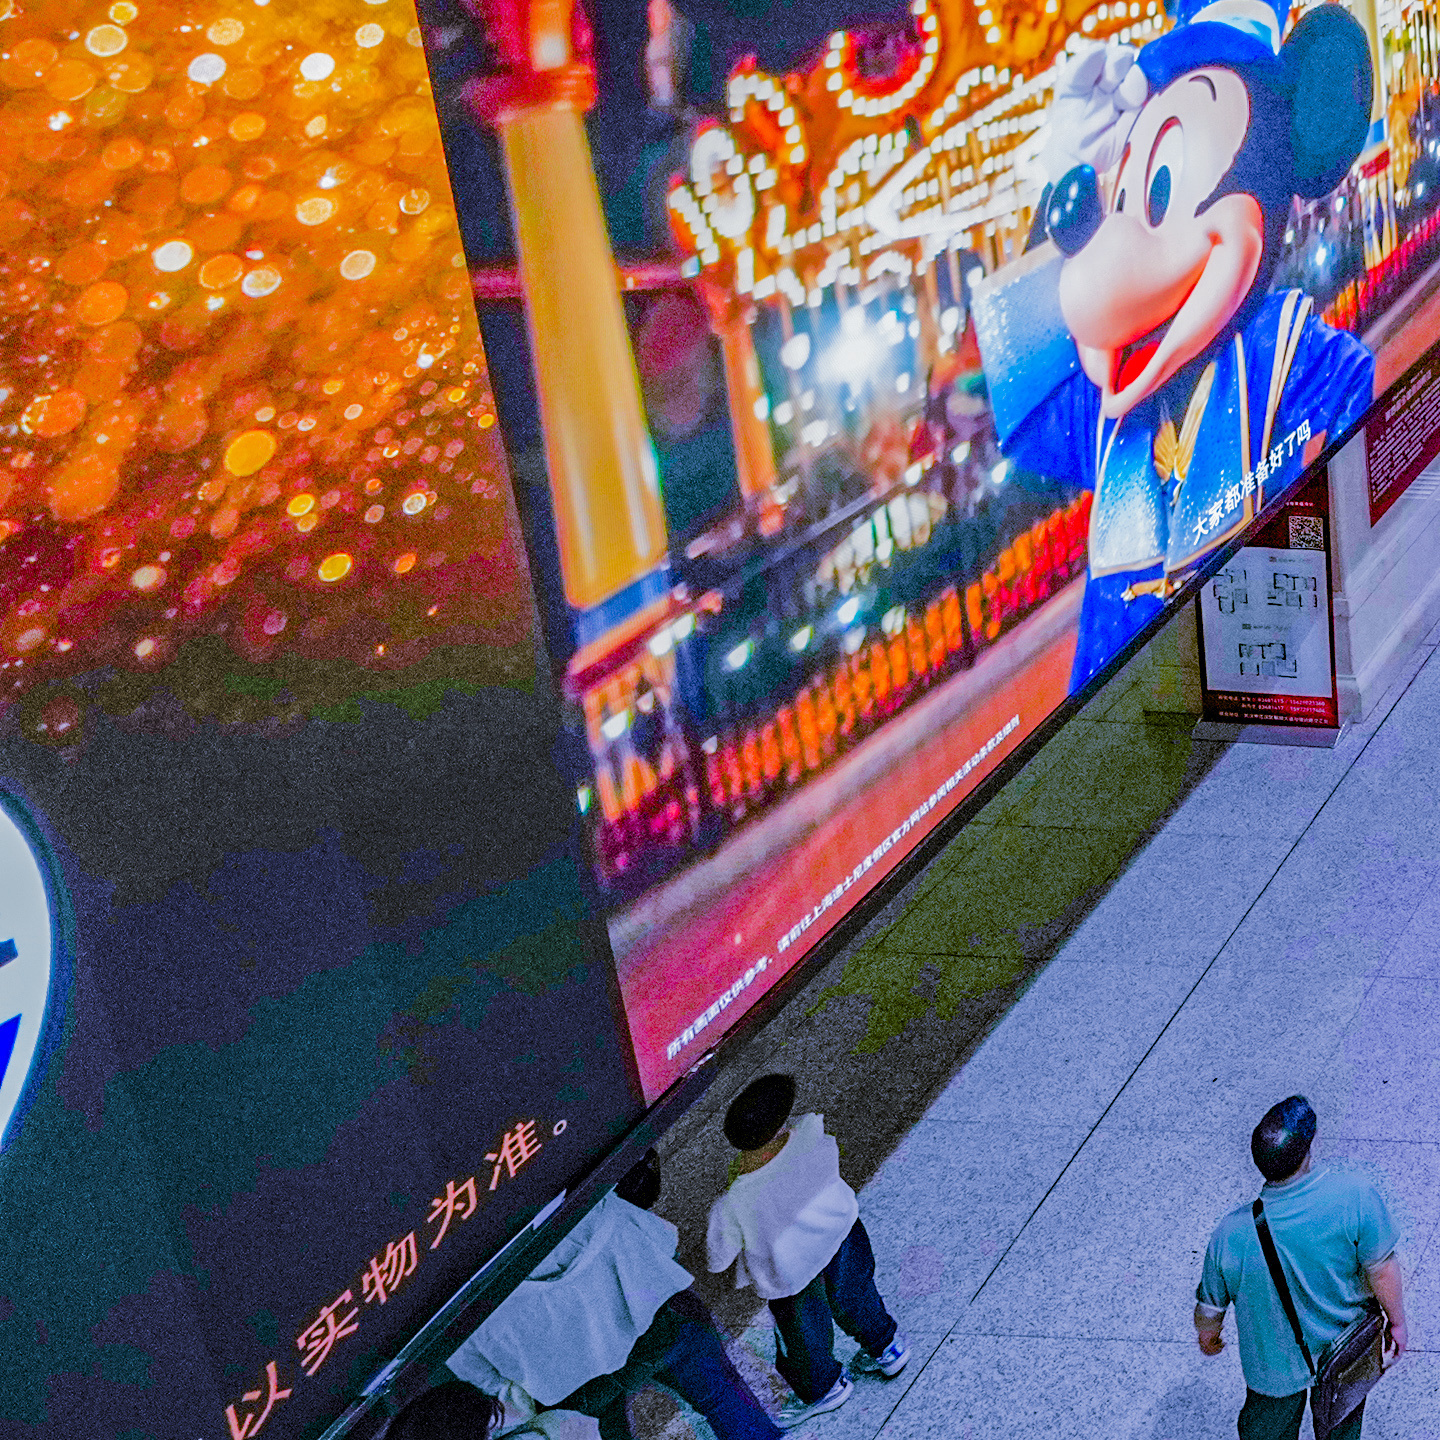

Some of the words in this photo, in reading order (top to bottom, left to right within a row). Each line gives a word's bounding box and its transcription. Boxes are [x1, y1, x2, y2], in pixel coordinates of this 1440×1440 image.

[1192, 418, 1311, 546] 大家都准备好了吗
